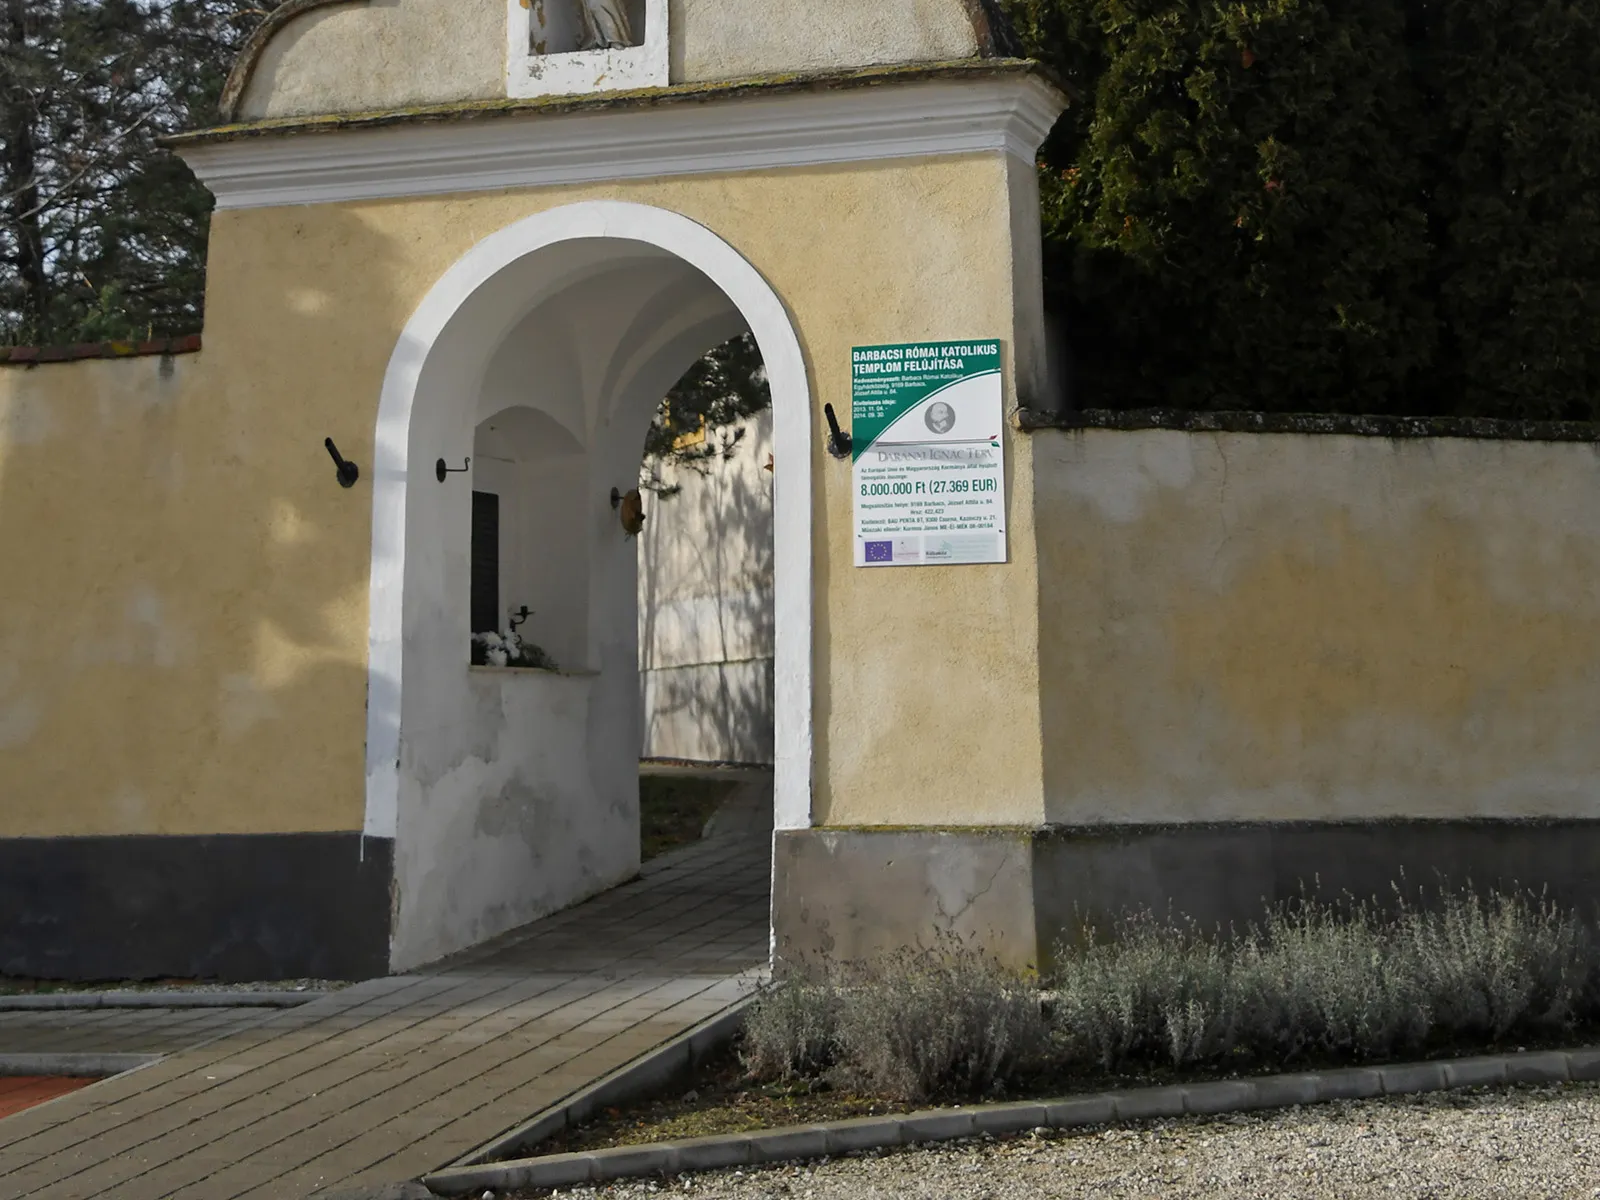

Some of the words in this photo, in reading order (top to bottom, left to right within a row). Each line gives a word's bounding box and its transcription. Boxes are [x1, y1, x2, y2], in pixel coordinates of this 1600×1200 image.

[853, 349, 903, 361] BARBACSI
[906, 346, 938, 359] RÓMAI
[942, 344, 997, 356] KATOLIKUS
[854, 362, 900, 374] TEMPLOM
[904, 358, 964, 371] FELÚJÍTÁSA
[861, 482, 912, 496] 8.000.000
[916, 481, 925, 494] Ft
[929, 480, 968, 494] (27.369
[972, 478, 997, 492] EUR)
